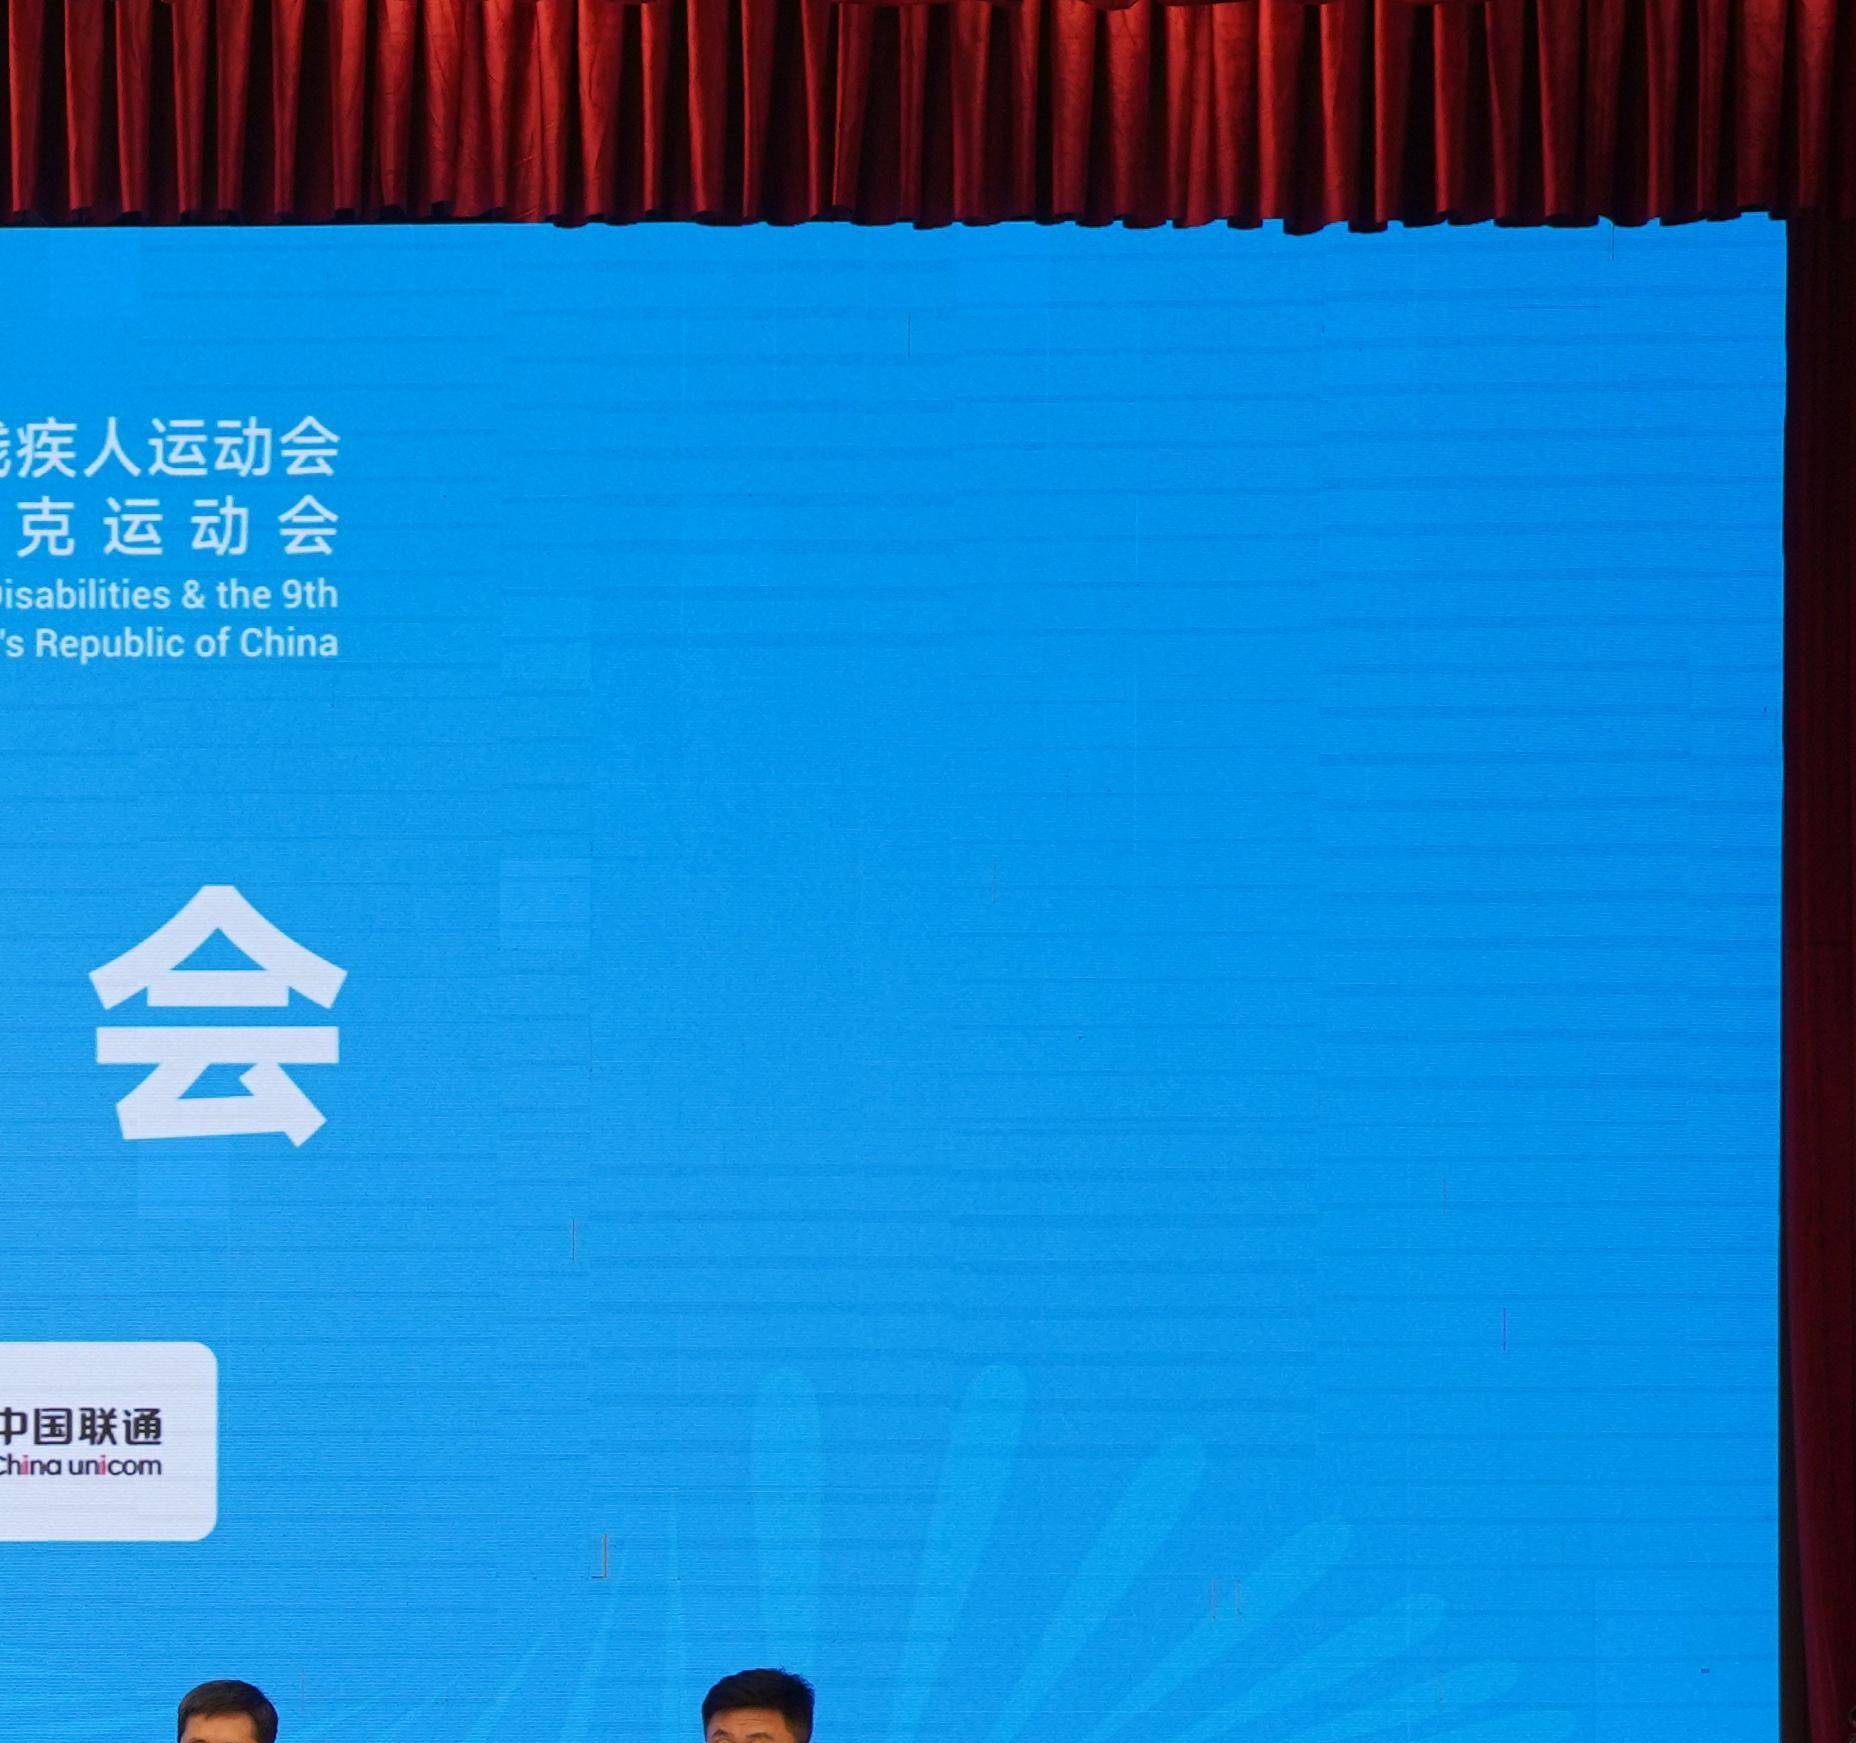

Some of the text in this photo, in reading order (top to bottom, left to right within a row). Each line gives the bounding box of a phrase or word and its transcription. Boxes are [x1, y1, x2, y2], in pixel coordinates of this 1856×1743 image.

[181, 579, 206, 610] &
[215, 578, 272, 610] the
[281, 577, 338, 609] 9th
[35, 626, 185, 665] Republic
[194, 625, 232, 658] of
[240, 625, 339, 658] China
[68, 1454, 163, 1476] unicom
